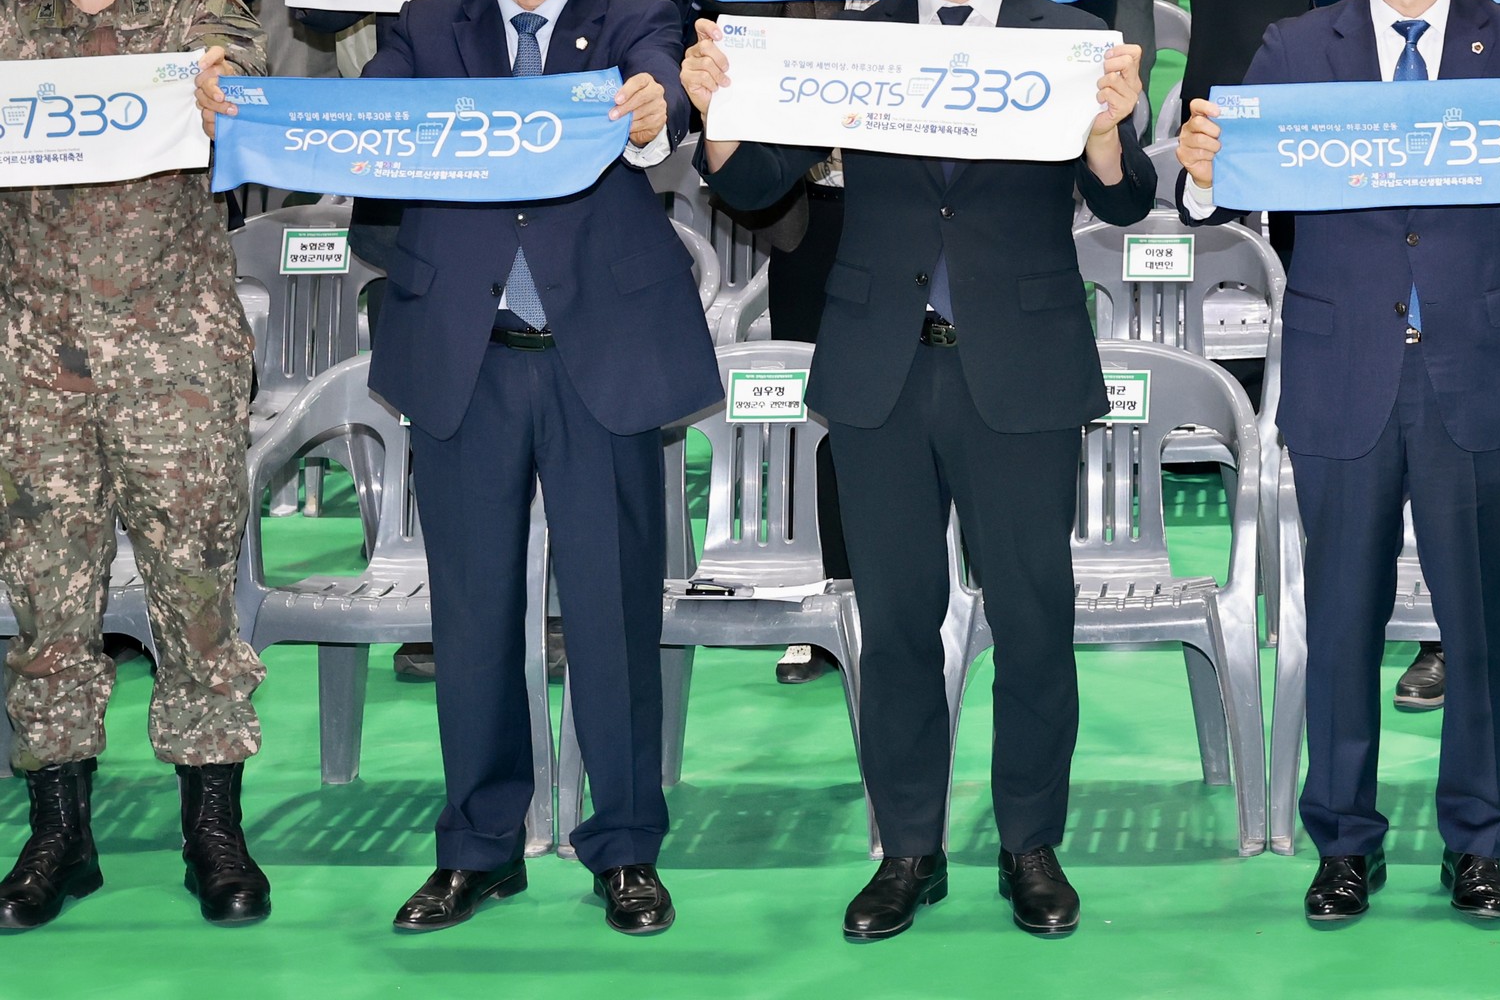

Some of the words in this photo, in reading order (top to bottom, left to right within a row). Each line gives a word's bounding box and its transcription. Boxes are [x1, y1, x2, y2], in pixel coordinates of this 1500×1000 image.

[723, 24, 747, 36] OK!
[724, 36, 767, 49] 전남시대
[783, 59, 814, 69] 일주일에
[852, 63, 885, 73] 하루30분
[888, 64, 903, 74] 운동
[779, 76, 905, 107] SPORTS
[919, 67, 1051, 113] 7330
[9, 92, 148, 139] 7330
[288, 112, 320, 122] 일주일에
[357, 112, 391, 122] 하루30분
[394, 111, 410, 121] 운동
[866, 112, 891, 121] 제21회
[865, 120, 979, 136] 전라남도어르신생활체육대축전
[1278, 123, 1309, 132] 일주일에
[1346, 123, 1381, 132] 하루30분
[1383, 122, 1397, 131] 운동
[284, 128, 416, 157] SPORTS
[427, 110, 562, 158] 7330
[1277, 139, 1406, 168] SPORTS
[374, 161, 401, 169] 제21회
[373, 168, 489, 180] 전라남도어르신생활체육대축전
[1370, 177, 1483, 189] 전라남도어르신생활체육대축전
[1145, 261, 1174, 270] 대변인
